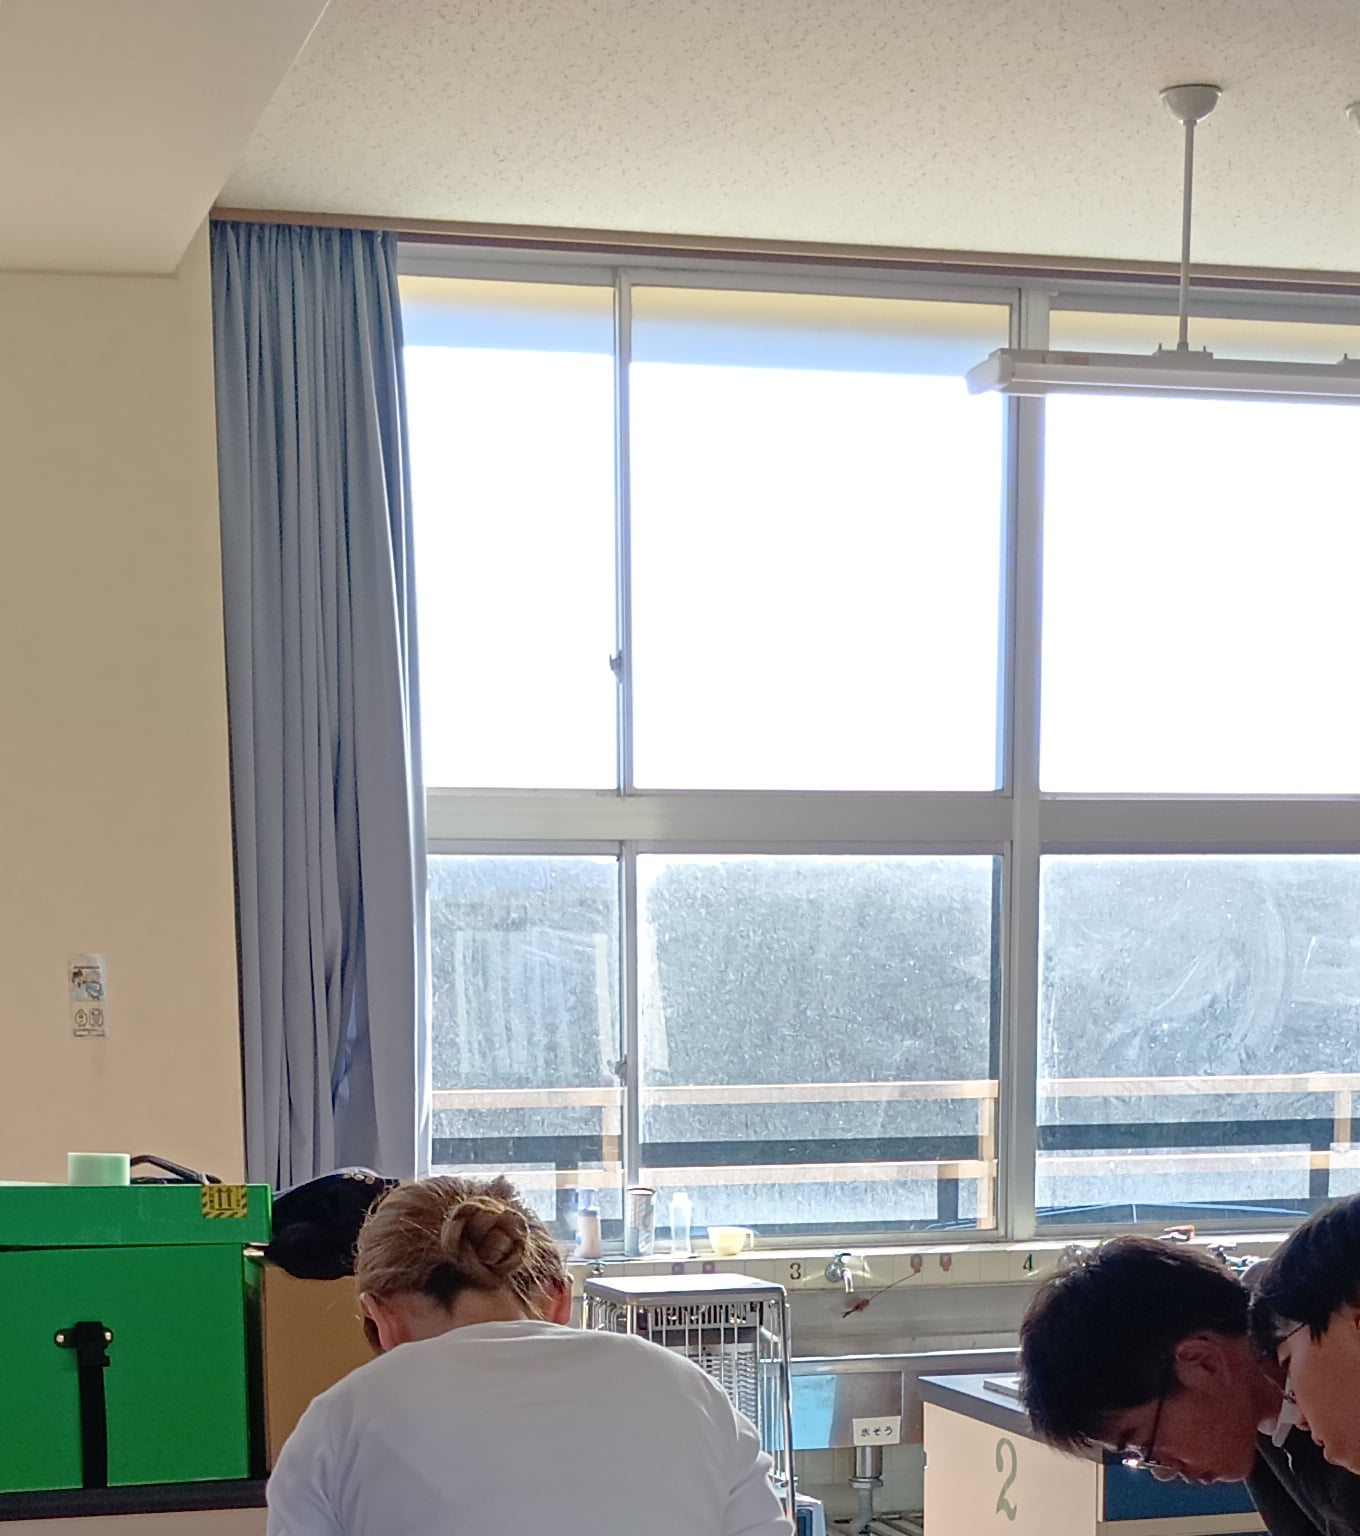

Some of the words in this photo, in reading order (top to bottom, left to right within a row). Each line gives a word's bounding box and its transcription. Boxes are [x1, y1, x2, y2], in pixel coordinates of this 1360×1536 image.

[789, 1262, 802, 1280] 3
[1022, 1253, 1034, 1272] 4
[995, 1437, 1017, 1521] 2
